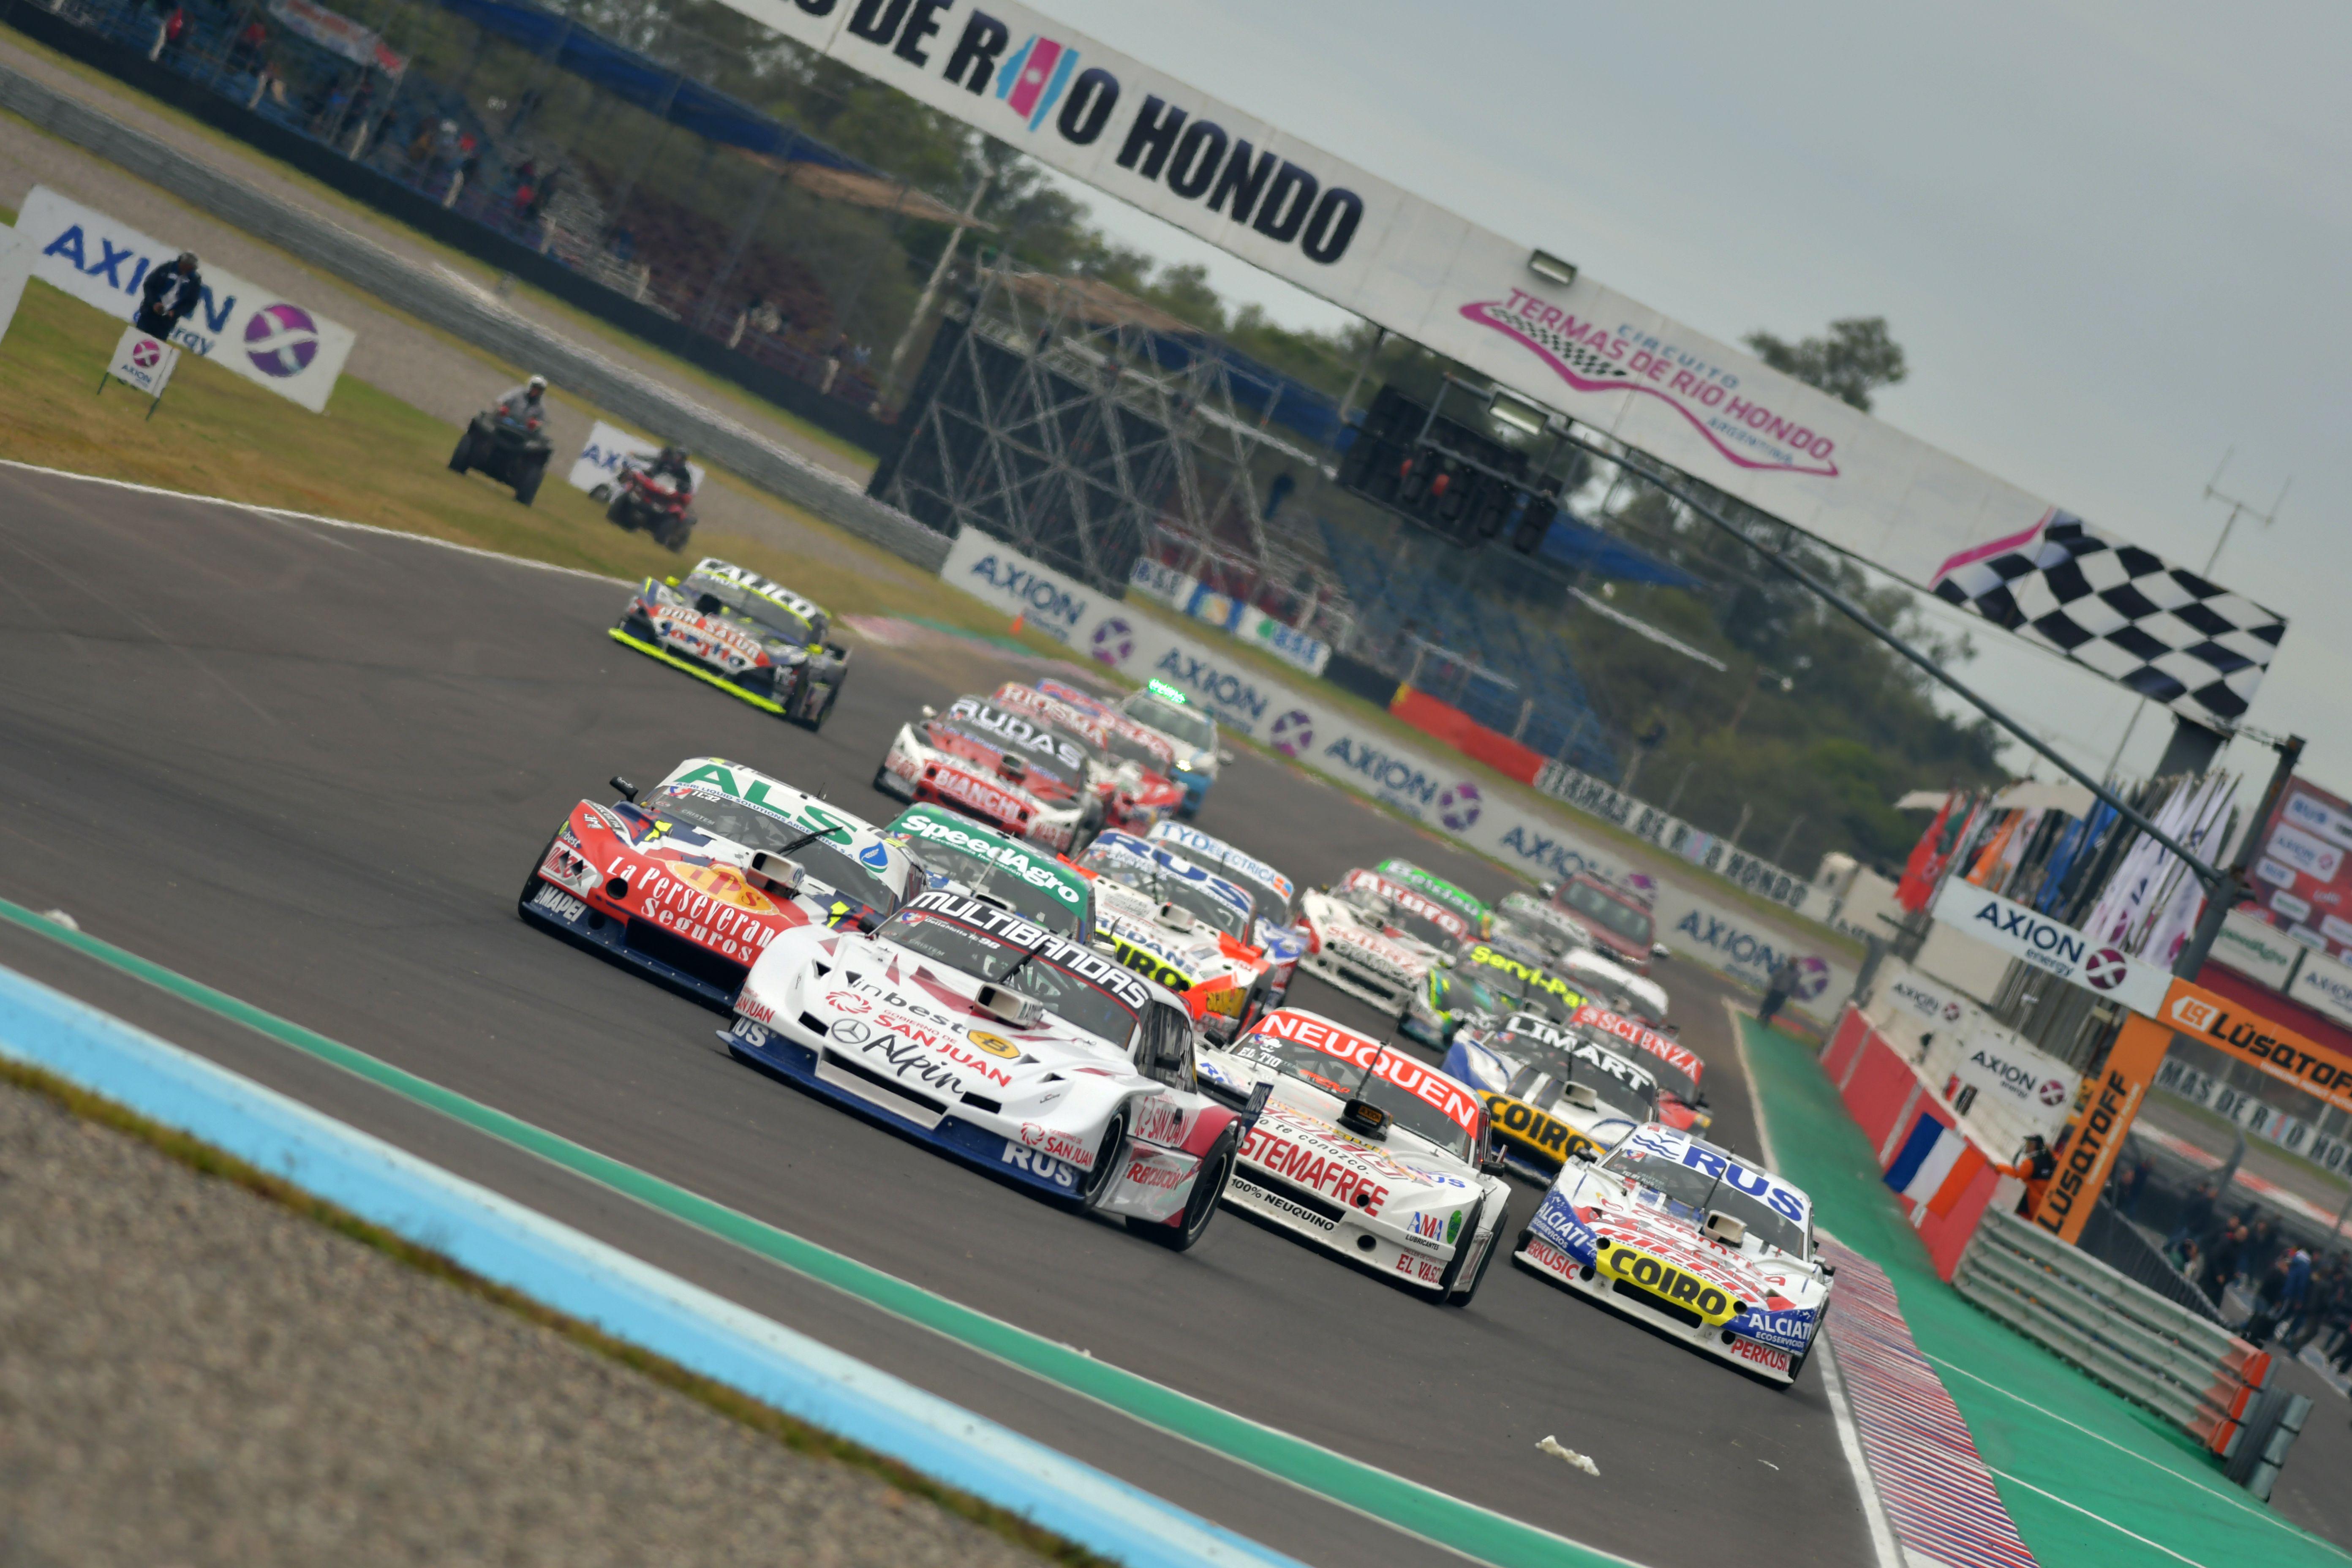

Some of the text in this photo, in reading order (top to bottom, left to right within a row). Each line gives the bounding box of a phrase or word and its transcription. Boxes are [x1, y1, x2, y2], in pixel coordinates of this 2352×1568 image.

[1115, 94, 1364, 266] HONDO
[44, 224, 237, 333] AXIN
[122, 364, 152, 384] AXION
[1505, 288, 1834, 460] TERMAS DE RIO HONDO
[1617, 324, 1740, 389] CIRCUITO
[972, 555, 1087, 625] AXION
[1156, 647, 1266, 720] AXION
[1324, 736, 1438, 803] AXION
[672, 764, 859, 845] ALS
[681, 809, 715, 825] CRISTEM
[936, 770, 1021, 820] BIANCHI
[701, 787, 733, 800] LIQUID
[735, 798, 786, 822] SOLUTIONS
[787, 821, 838, 850] ARGETINA
[840, 848, 855, 860] S.A.
[930, 836, 976, 856] Excelencia
[607, 856, 637, 882] La
[901, 815, 1080, 903] SpeedAgro
[1162, 824, 1276, 887] TYD ELECTRICA
[1500, 825, 1592, 878] AXIO
[539, 886, 588, 922] MAPEI
[641, 897, 753, 961] Seguros
[907, 891, 1150, 1010] MULTIBANDAS
[909, 938, 945, 956] CRISTEM
[1677, 909, 1786, 984] AXION
[1975, 901, 2086, 964] AXION
[2026, 947, 2074, 976] energy
[735, 995, 776, 1024] AN JUAN
[852, 976, 967, 1034] inbest
[1892, 982, 1939, 1011] AXION
[732, 1016, 769, 1047] US
[873, 1014, 1013, 1089] SAN JUAN
[883, 1009, 959, 1045] GOBIERNO DE
[1237, 1046, 1282, 1068] EL TIO
[1261, 1014, 1476, 1128] NEUQUEN
[1506, 1015, 1652, 1091] LIMART
[1971, 1050, 2038, 1092] AXION
[2209, 1012, 2352, 1098] LÜSQTOF
[1246, 1084, 1268, 1113] RUS
[1360, 1107, 1381, 1122] AXION
[2000, 1080, 2028, 1100] energy
[1275, 1123, 1293, 1135] te
[1298, 1134, 1370, 1175] conozco.
[1486, 1095, 1592, 1157] COIRO
[1002, 1140, 1073, 1187] RUS
[1044, 1136, 1094, 1167] SAN JUAN
[2037, 1070, 2127, 1235] LÜSQTOFF
[1230, 1178, 1335, 1231] 100% NEUQUINO
[1682, 1145, 1804, 1221] RUS
[1405, 1234, 1440, 1251] LUBRICANTES
[1407, 1211, 1443, 1241] AMA
[1532, 1216, 1568, 1249] ECOSERVICIOS
[1535, 1201, 1590, 1247] ALCIATI
[1396, 1253, 1443, 1284] EL VASCO
[1526, 1239, 1579, 1280] PERKUSIC
[1610, 1248, 1727, 1315] COIRO
[1748, 1313, 1813, 1340] ALCIATI
[1756, 1331, 1805, 1348] ECOSERVICIOS
[1731, 1338, 1792, 1372] PERKUSIC
